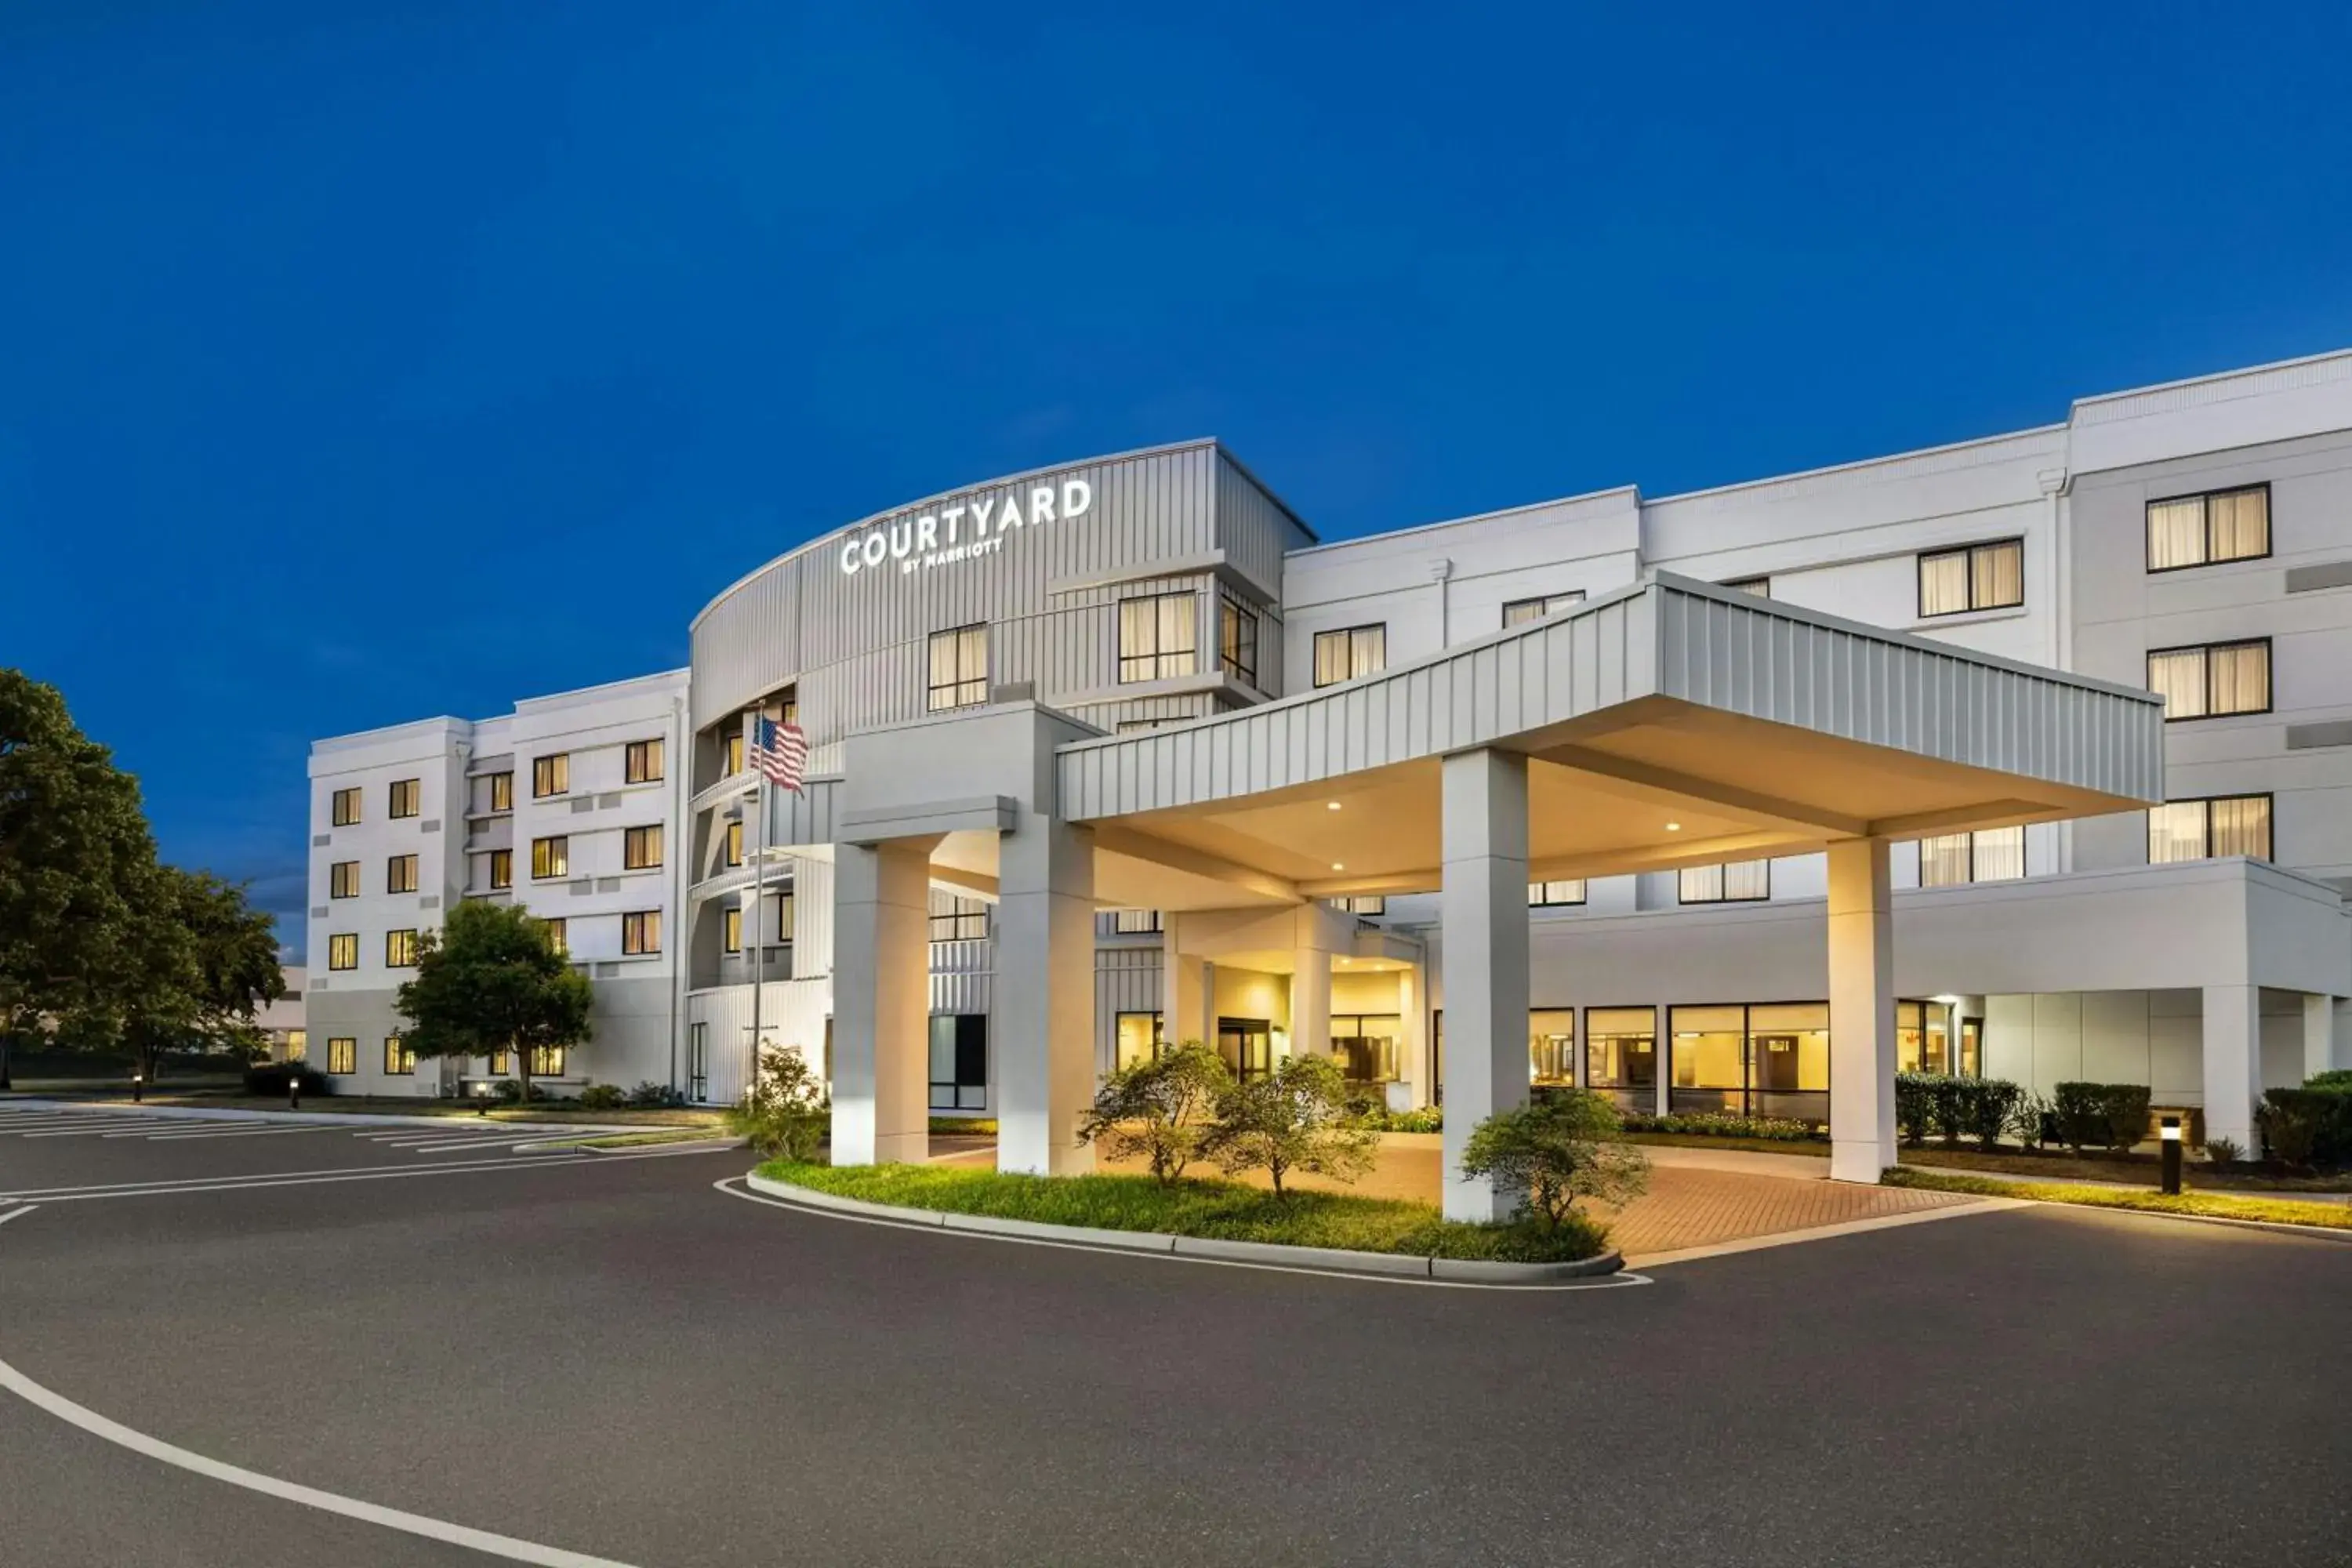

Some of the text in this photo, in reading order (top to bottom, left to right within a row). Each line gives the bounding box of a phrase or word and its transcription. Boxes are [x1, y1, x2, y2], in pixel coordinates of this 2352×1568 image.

[841, 481, 1091, 575] COURTYARD
[903, 538, 1003, 574] BY MARRIOTT
